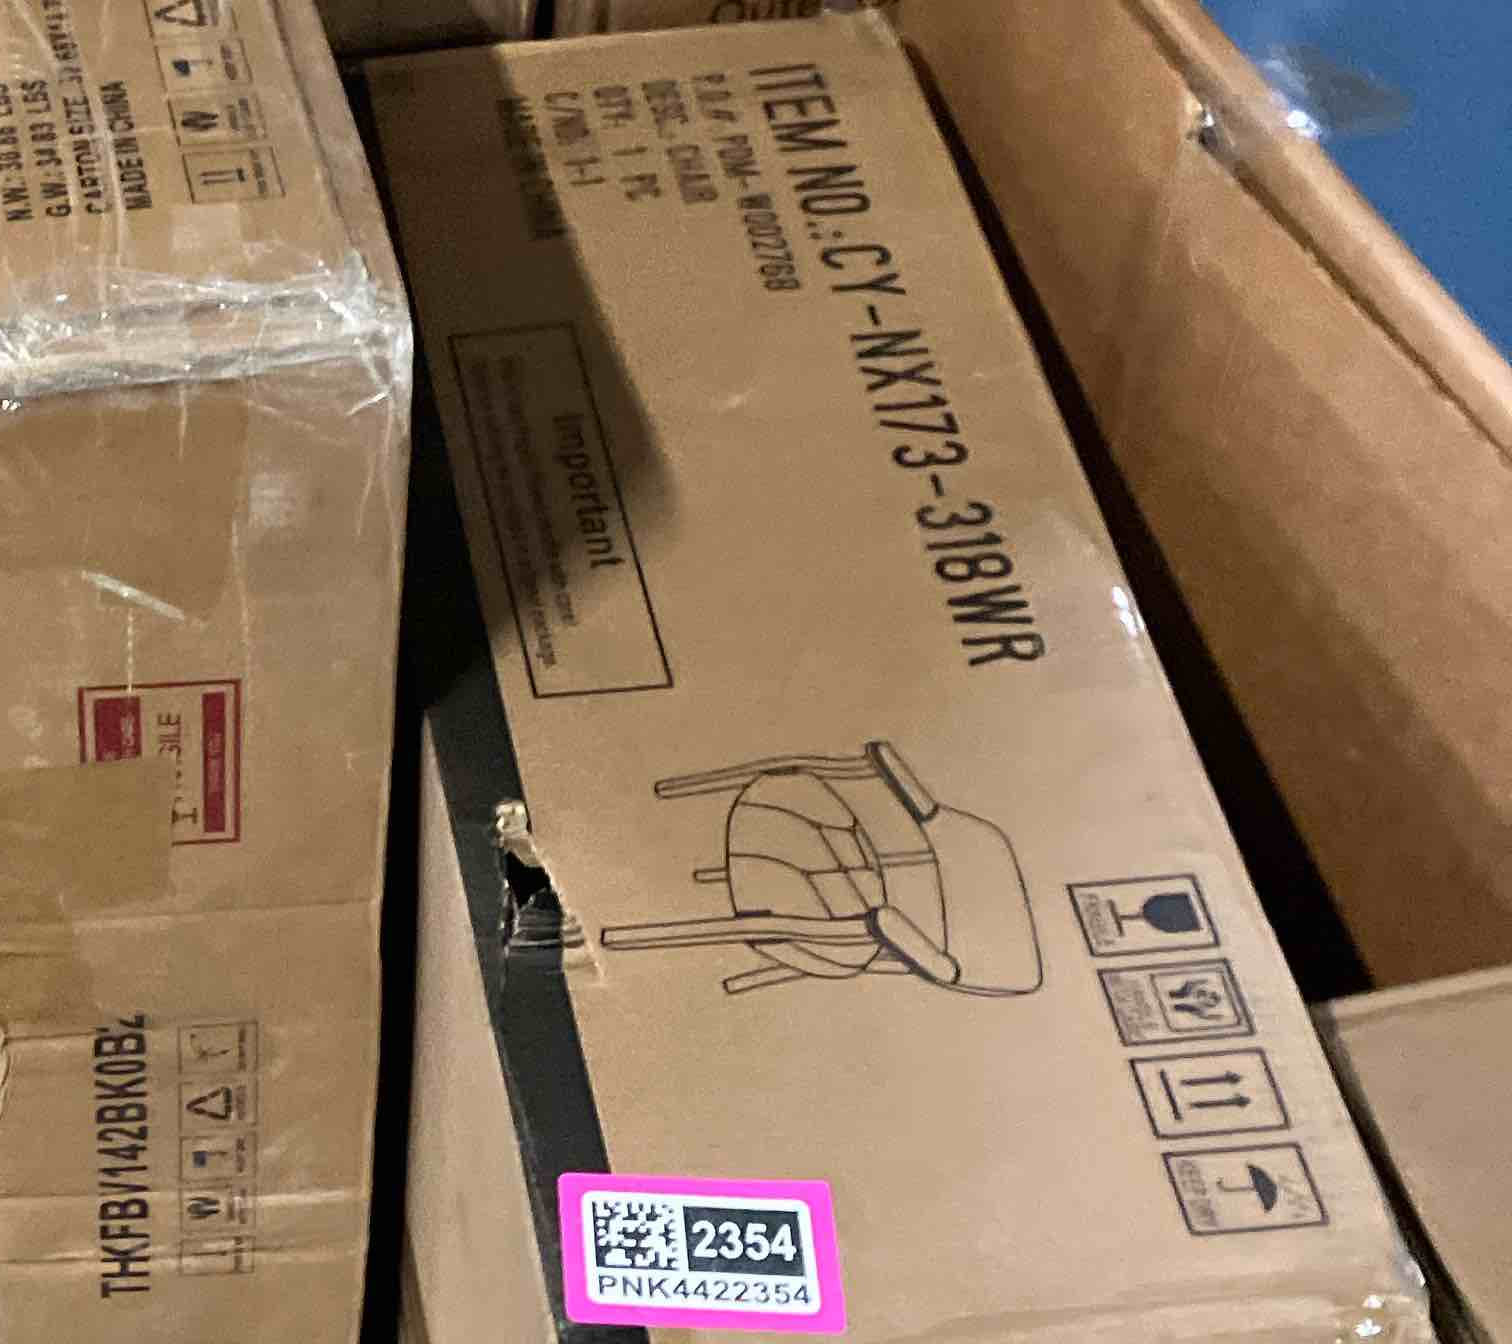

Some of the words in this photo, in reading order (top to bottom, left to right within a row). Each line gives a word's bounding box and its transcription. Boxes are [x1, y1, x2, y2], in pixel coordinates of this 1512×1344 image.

[20, 79, 52, 114] LBS
[99, 79, 135, 134] CHINA
[750, 62, 849, 156] ITEM
[113, 136, 140, 155] IN
[117, 156, 153, 211] MADE
[553, 409, 625, 570] Important
[691, 1219, 798, 1263] 2354
[597, 1274, 811, 1305] PNK4422354
